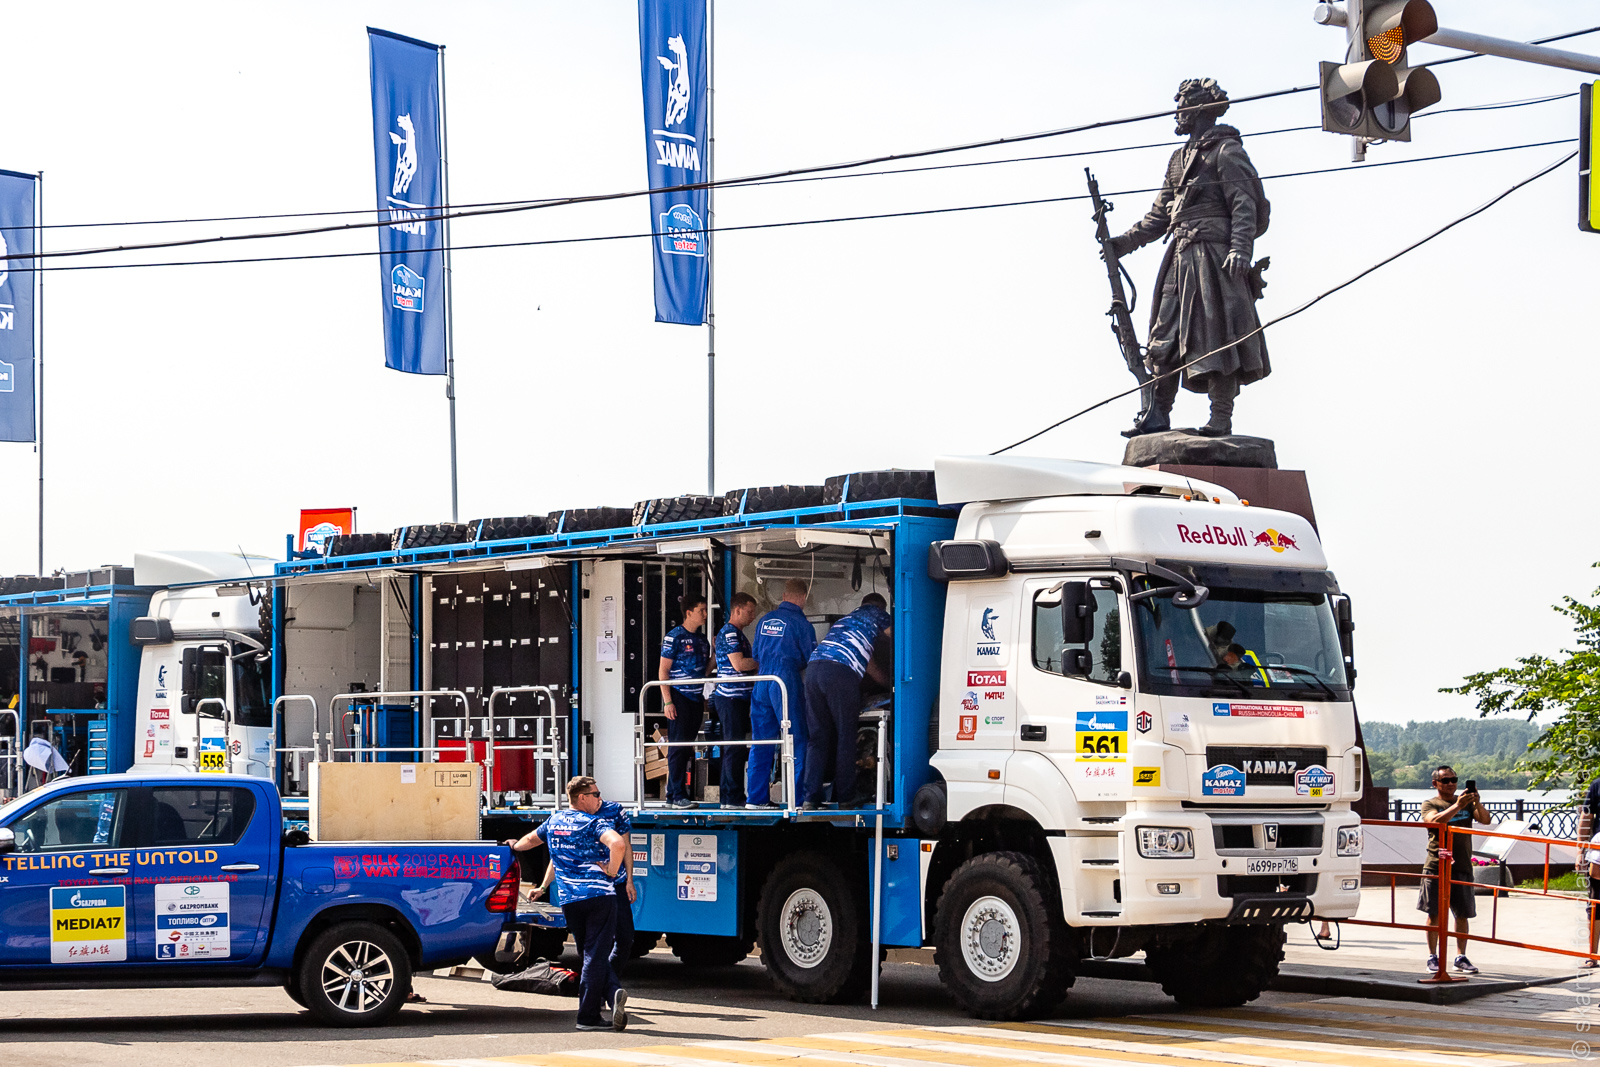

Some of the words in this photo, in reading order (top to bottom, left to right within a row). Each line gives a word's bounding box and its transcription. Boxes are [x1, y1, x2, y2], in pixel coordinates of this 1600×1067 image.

[977, 647, 1000, 656] KAMAZ
[969, 673, 1005, 685] TOTAL
[151, 711, 170, 719] TOTAL
[1082, 735, 1119, 758] 561
[203, 754, 224, 770] 558
[1242, 760, 1297, 774] KAMAZ
[1214, 766, 1234, 778] Team
[1205, 779, 1242, 787] KAMAZ
[3, 855, 85, 870] TELLING
[91, 853, 130, 867] THE
[136, 850, 218, 865] UNTOLD
[362, 854, 400, 866] SILK
[403, 854, 437, 866] 2019
[439, 855, 488, 866] RALLY
[363, 866, 400, 877] WAY
[58, 878, 99, 887] TOYOTA
[113, 877, 132, 885] THE
[134, 876, 167, 884] RALLY
[169, 875, 212, 883] OFFICIAL
[217, 874, 239, 882] CAR
[56, 917, 121, 930] MEDIA17
[168, 917, 199, 925] ТОПЛИВО
